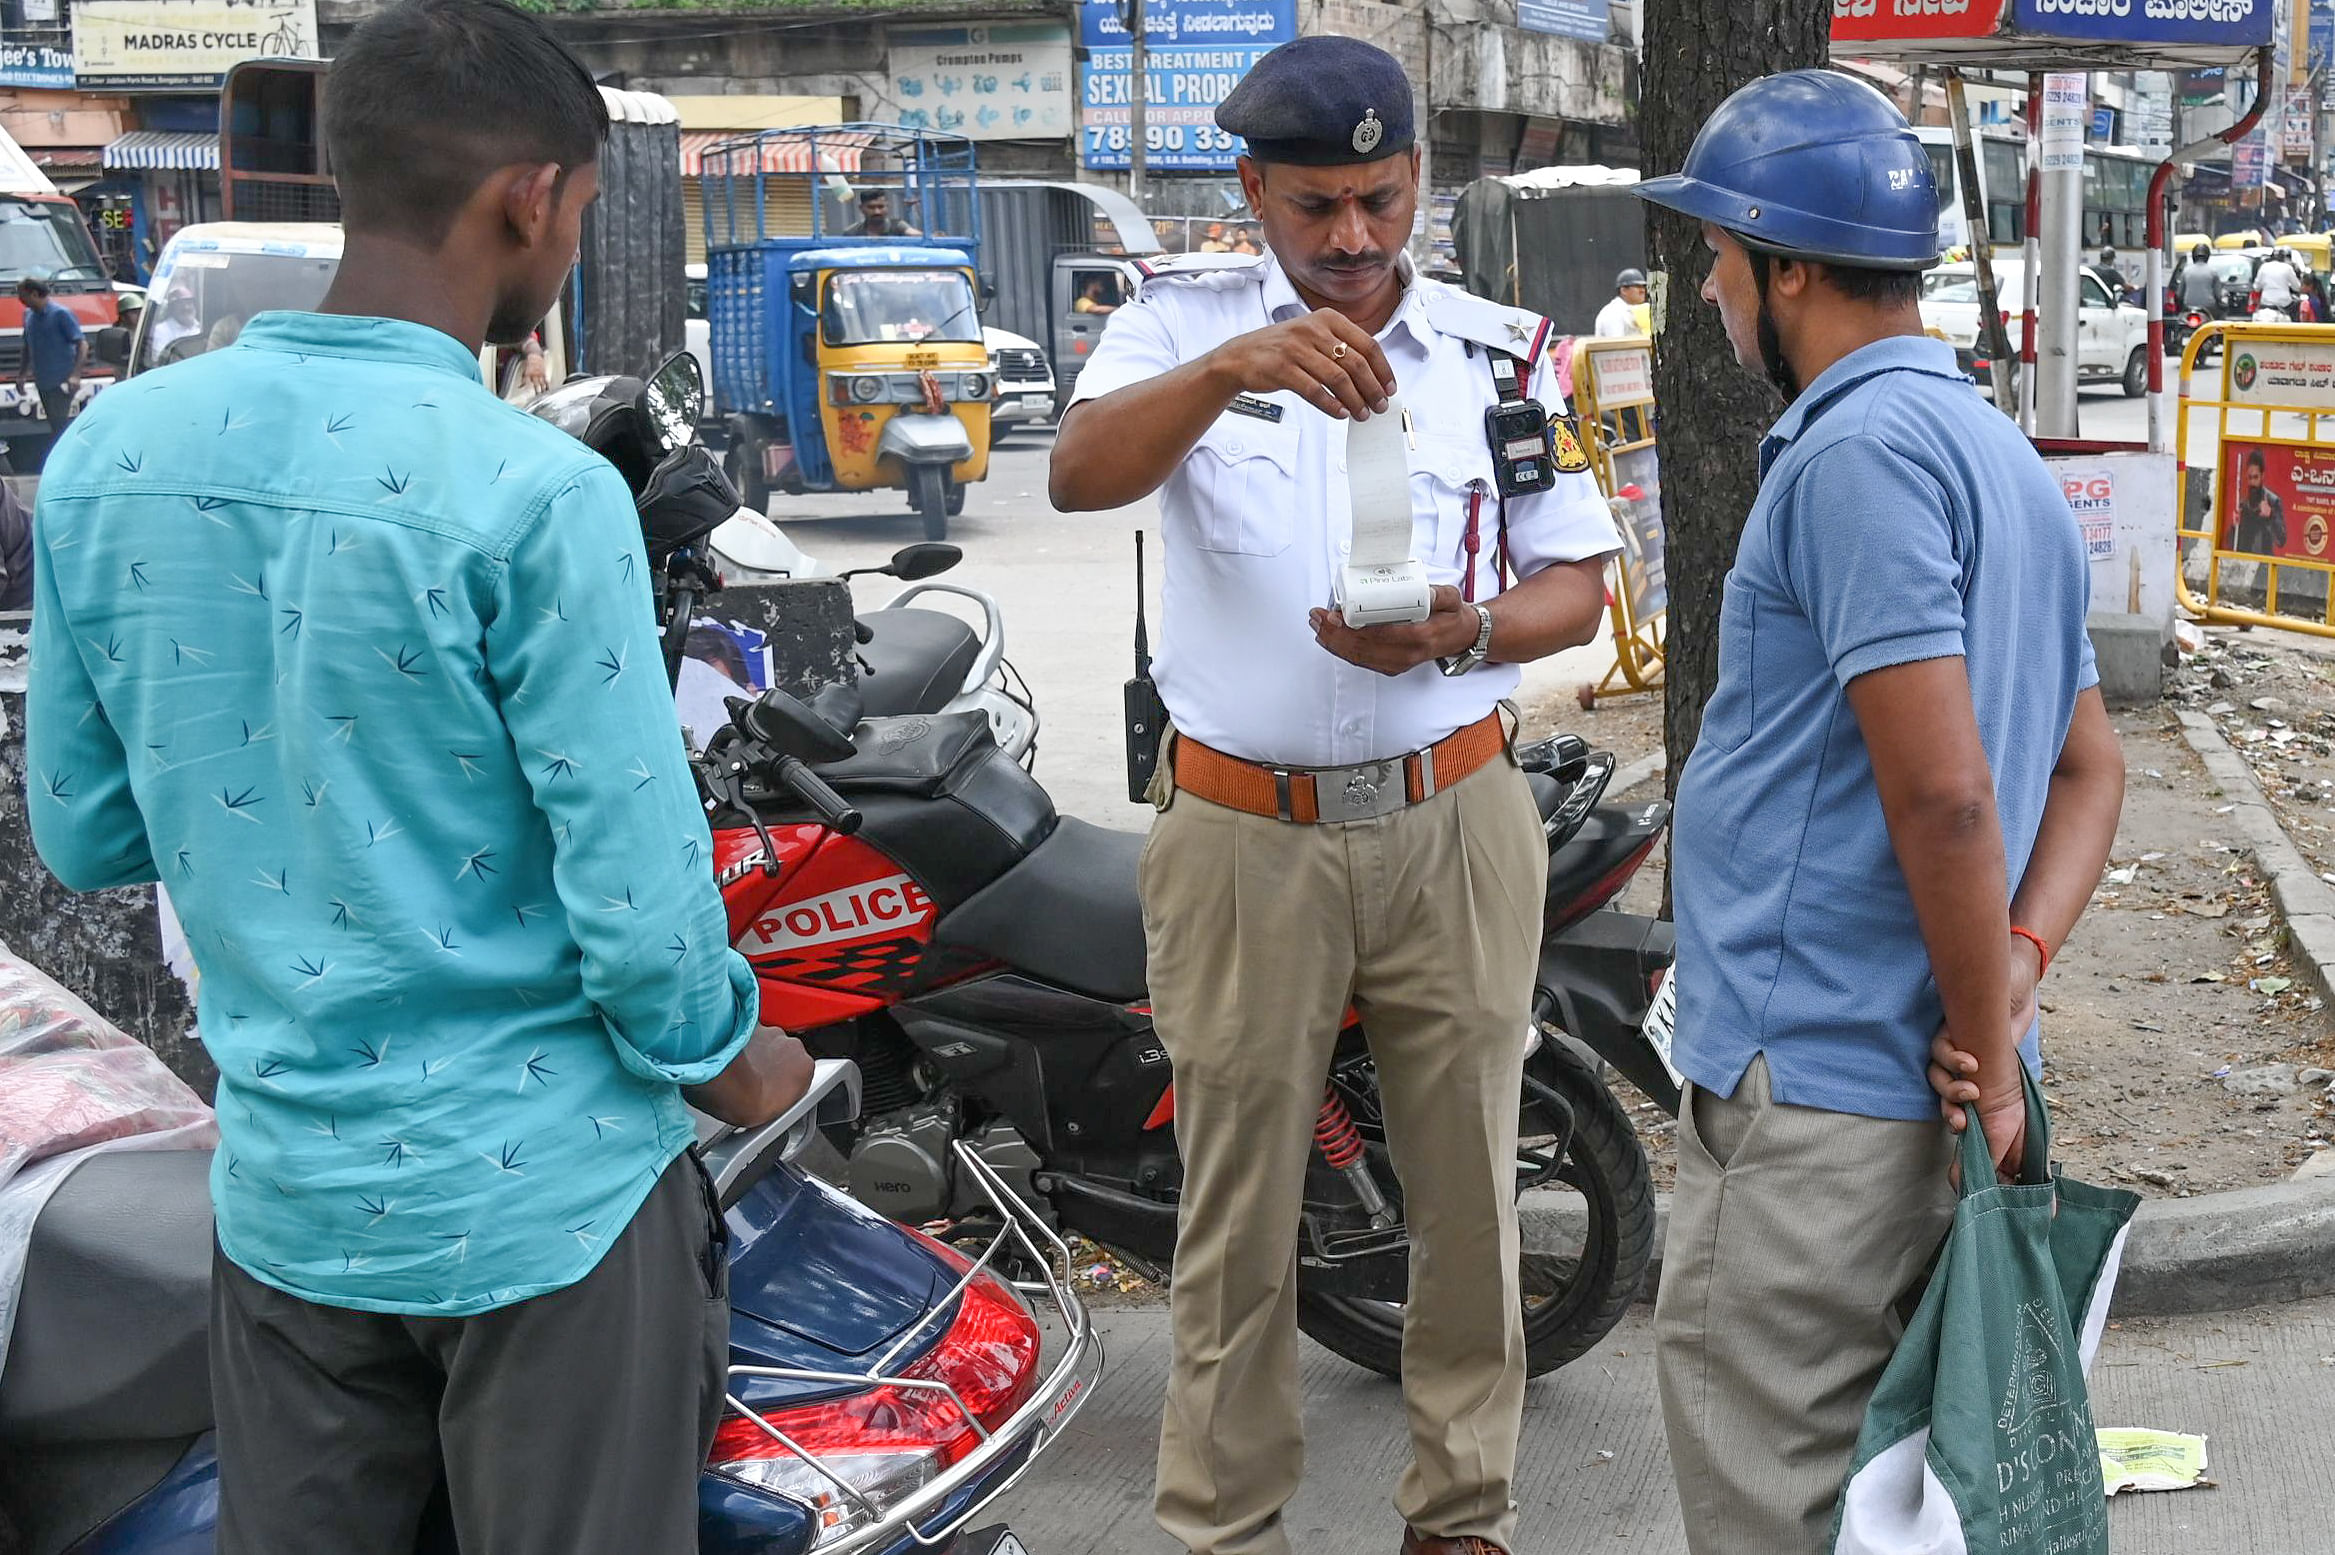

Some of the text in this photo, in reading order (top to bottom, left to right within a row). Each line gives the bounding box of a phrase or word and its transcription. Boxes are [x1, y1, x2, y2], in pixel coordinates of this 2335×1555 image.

[124, 33, 197, 50] MADRAS
[203, 32, 257, 49] CYCLE
[936, 52, 1023, 67] Crompton Pumps
[1092, 52, 1133, 70] BEST
[1143, 51, 1244, 69] REATMENT
[1144, 110, 1167, 124] OR
[2063, 479, 2111, 501] PG
[752, 881, 933, 945] POLICE
